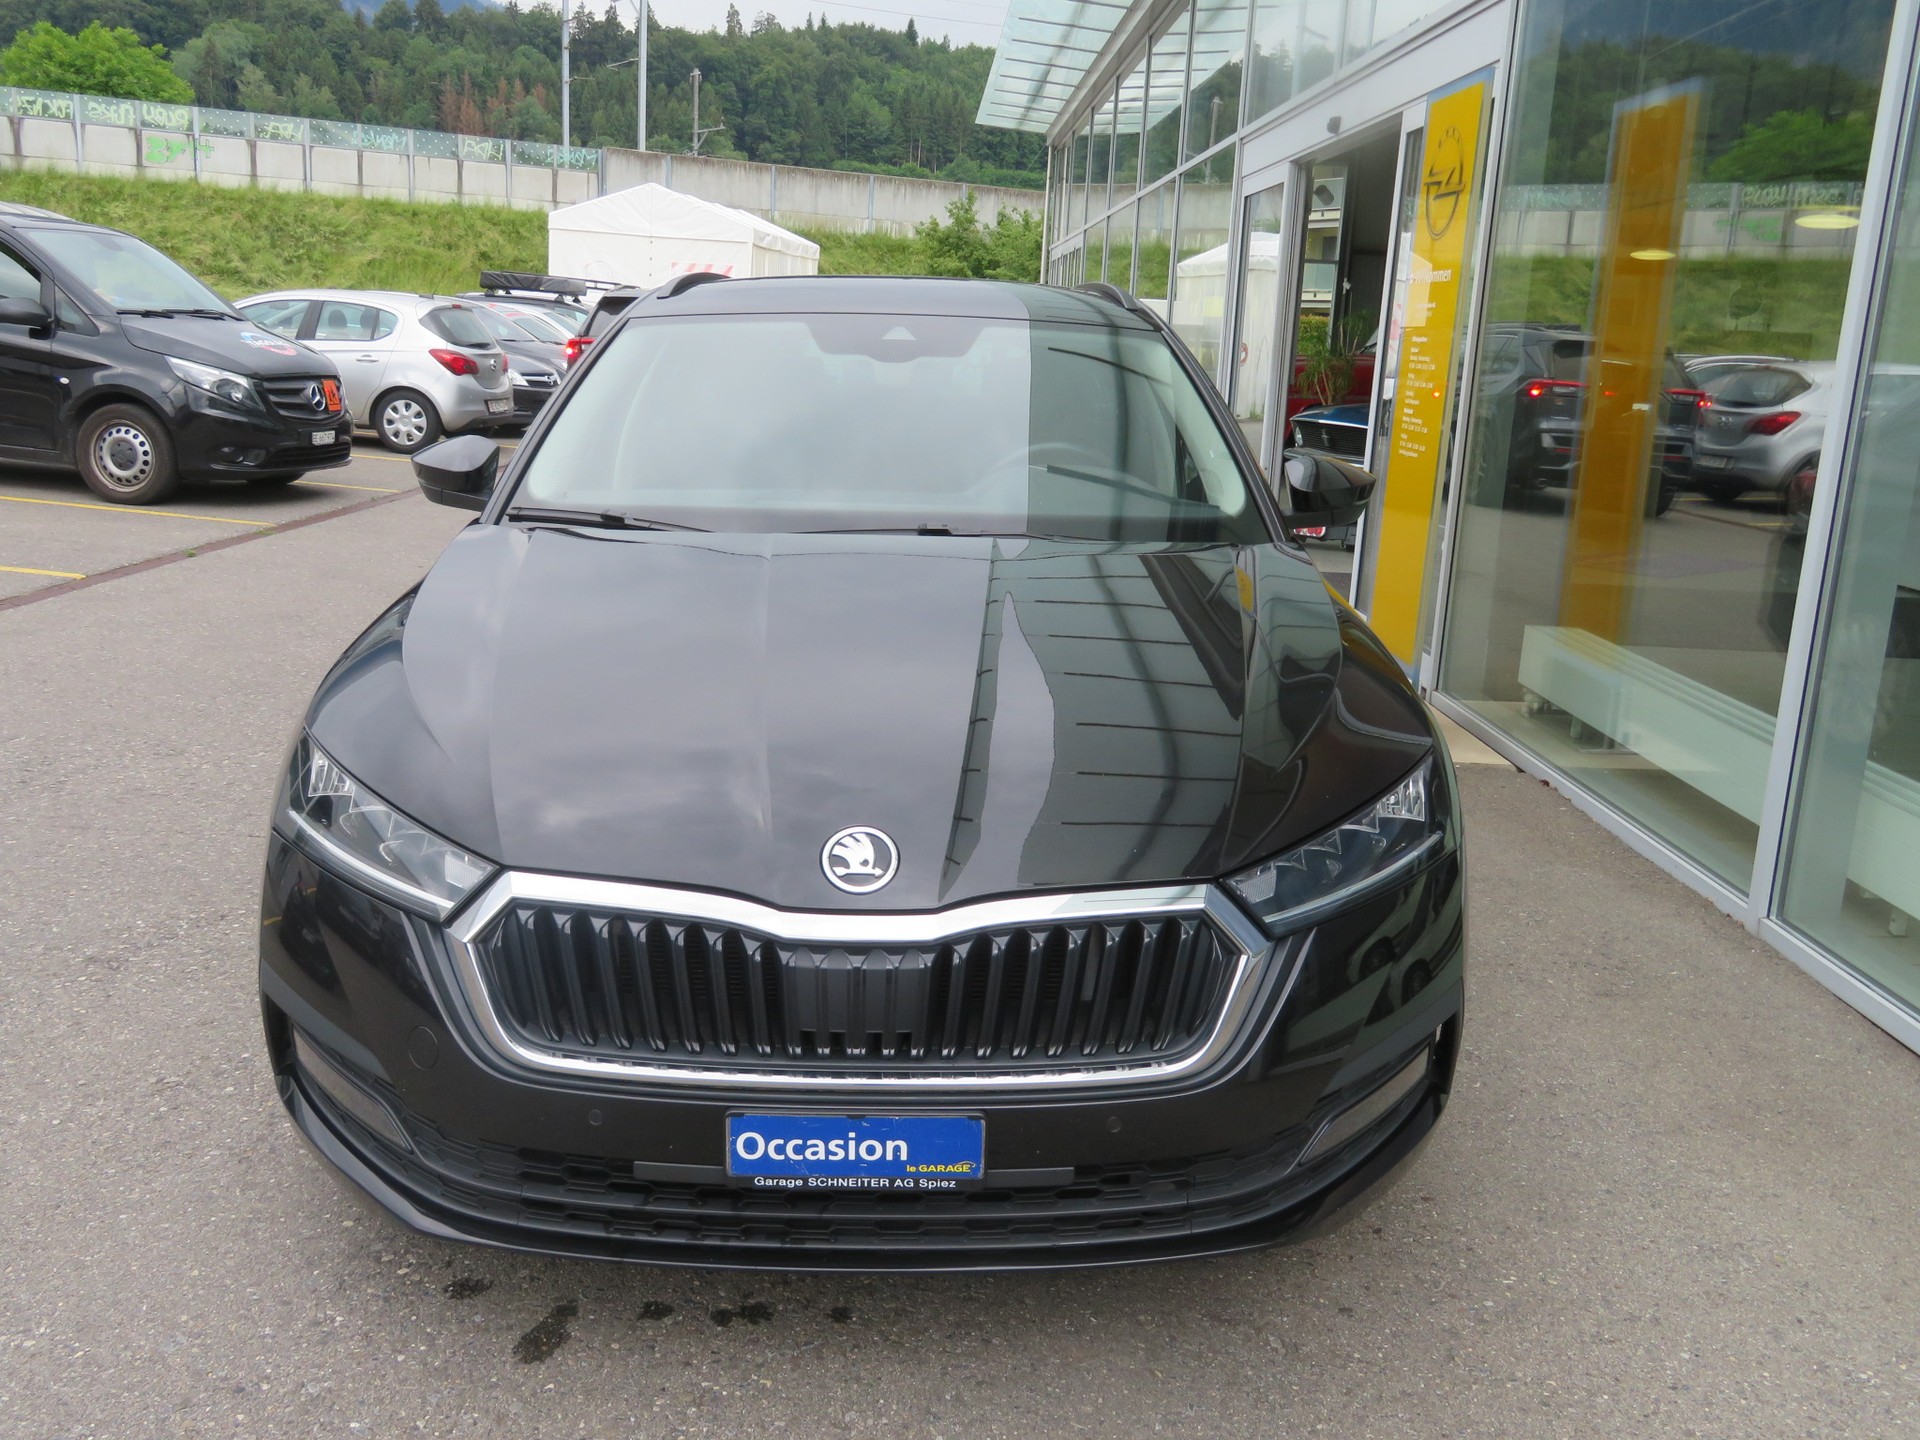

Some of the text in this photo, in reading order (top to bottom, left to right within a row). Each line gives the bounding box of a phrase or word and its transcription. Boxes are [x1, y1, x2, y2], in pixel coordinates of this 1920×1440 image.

[735, 1132, 908, 1161] Occasion
[906, 1163, 971, 1173] le GARAGE
[754, 1176, 956, 1188] Garage SCHNEITER AG Spiez
